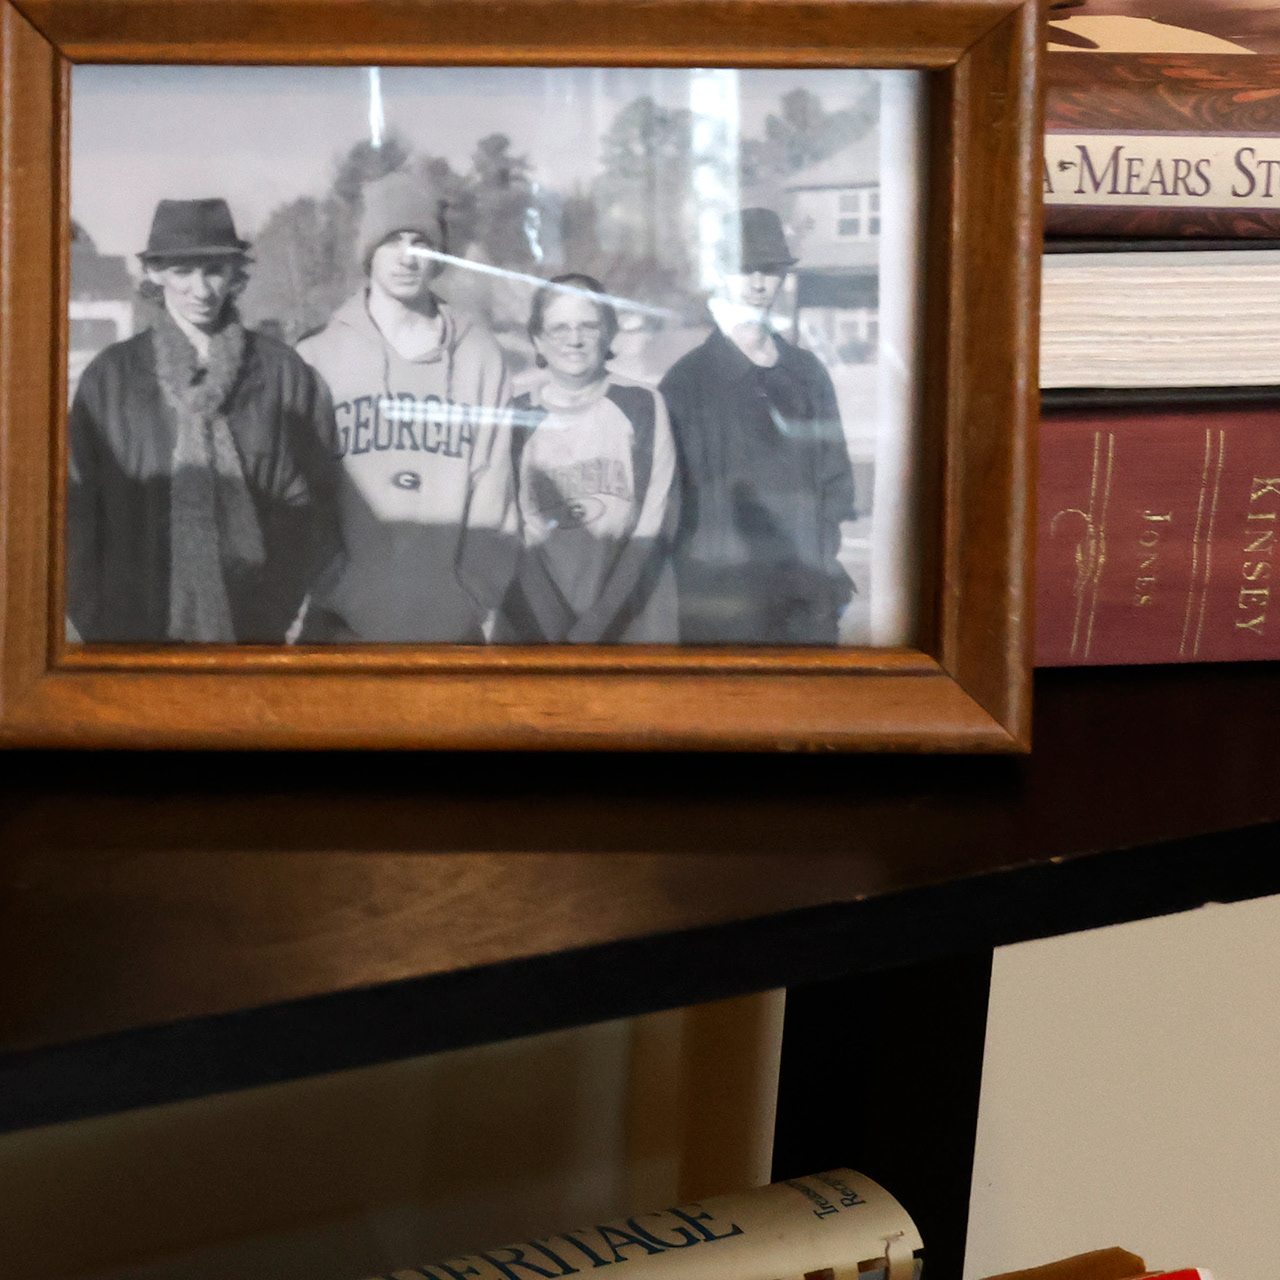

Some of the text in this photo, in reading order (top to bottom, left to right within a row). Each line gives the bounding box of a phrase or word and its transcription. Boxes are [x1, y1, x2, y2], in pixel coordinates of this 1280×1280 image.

[1231, 147, 1280, 197] ST
[1236, 476, 1280, 636] KINSEY
[380, 1203, 745, 1280] ERITAGE
